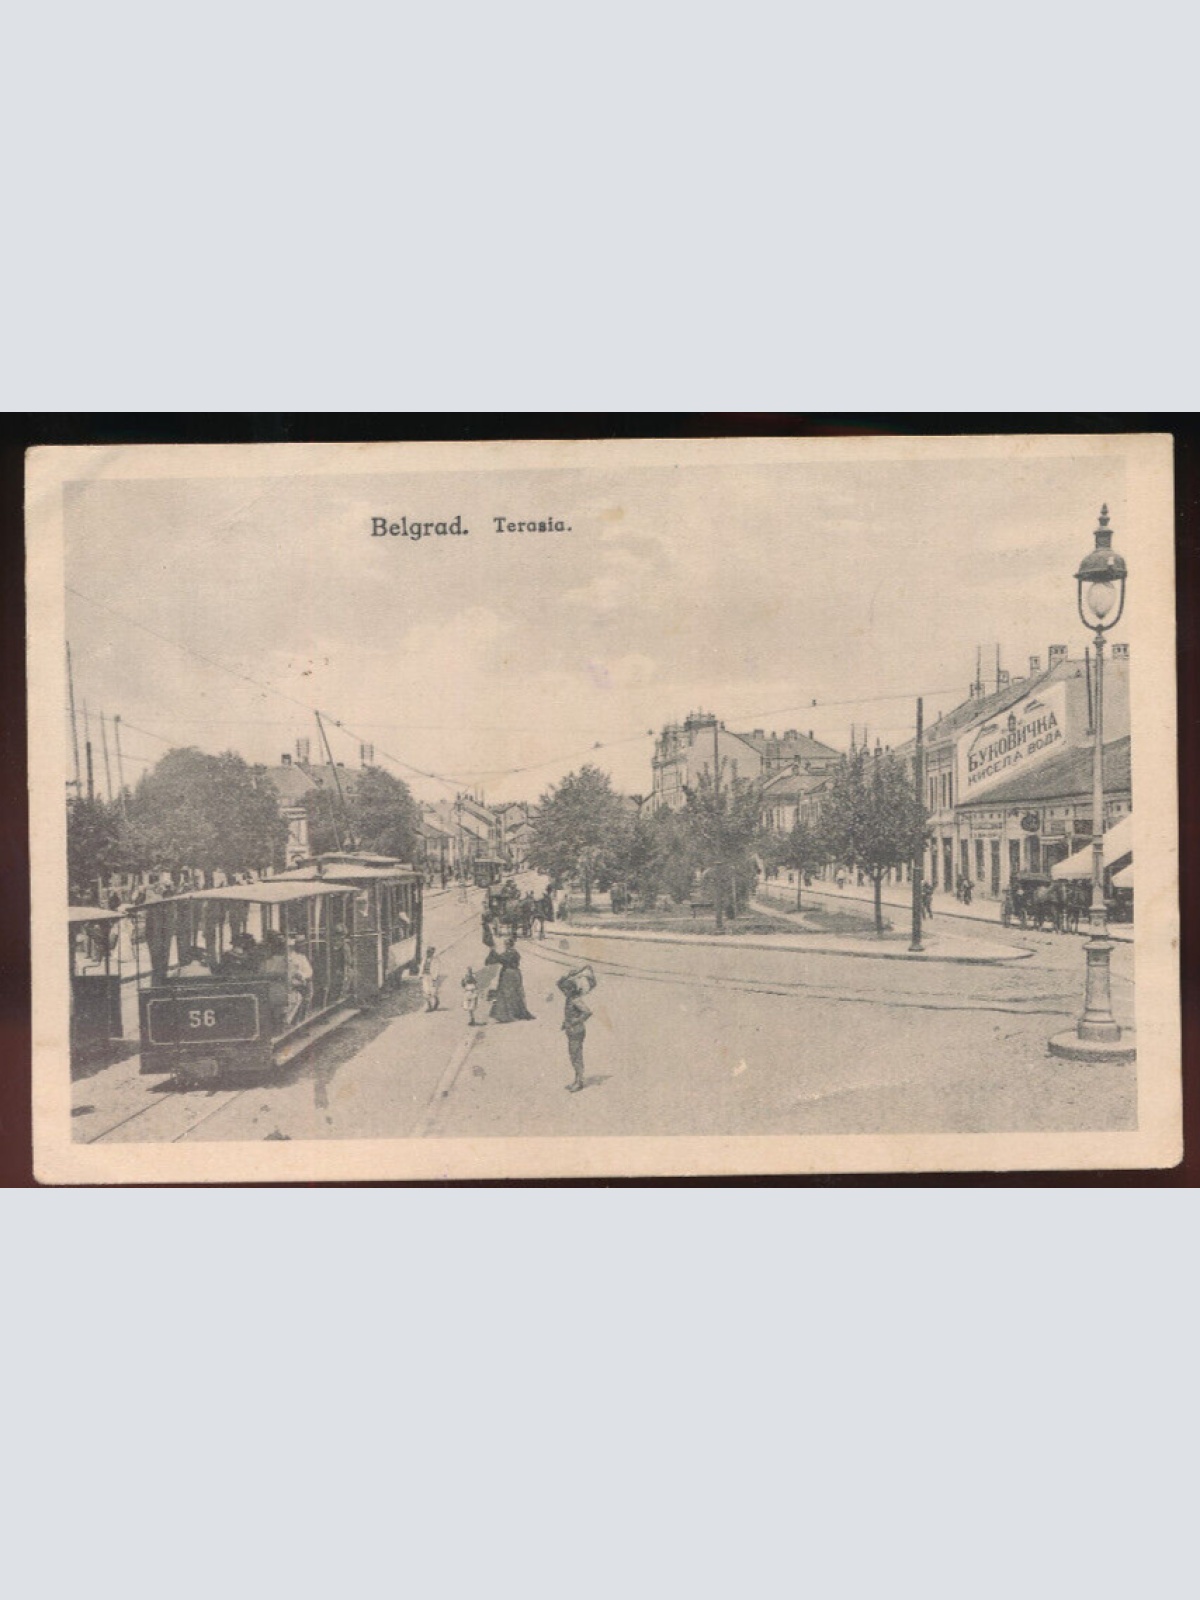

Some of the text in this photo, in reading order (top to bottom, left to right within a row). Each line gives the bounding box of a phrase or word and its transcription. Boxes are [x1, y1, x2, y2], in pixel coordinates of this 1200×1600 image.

[967, 729, 1062, 786] КИСЕЛА ВОДА
[968, 710, 1058, 773] БУКОВИЧКА
[189, 1009, 216, 1028] 56
